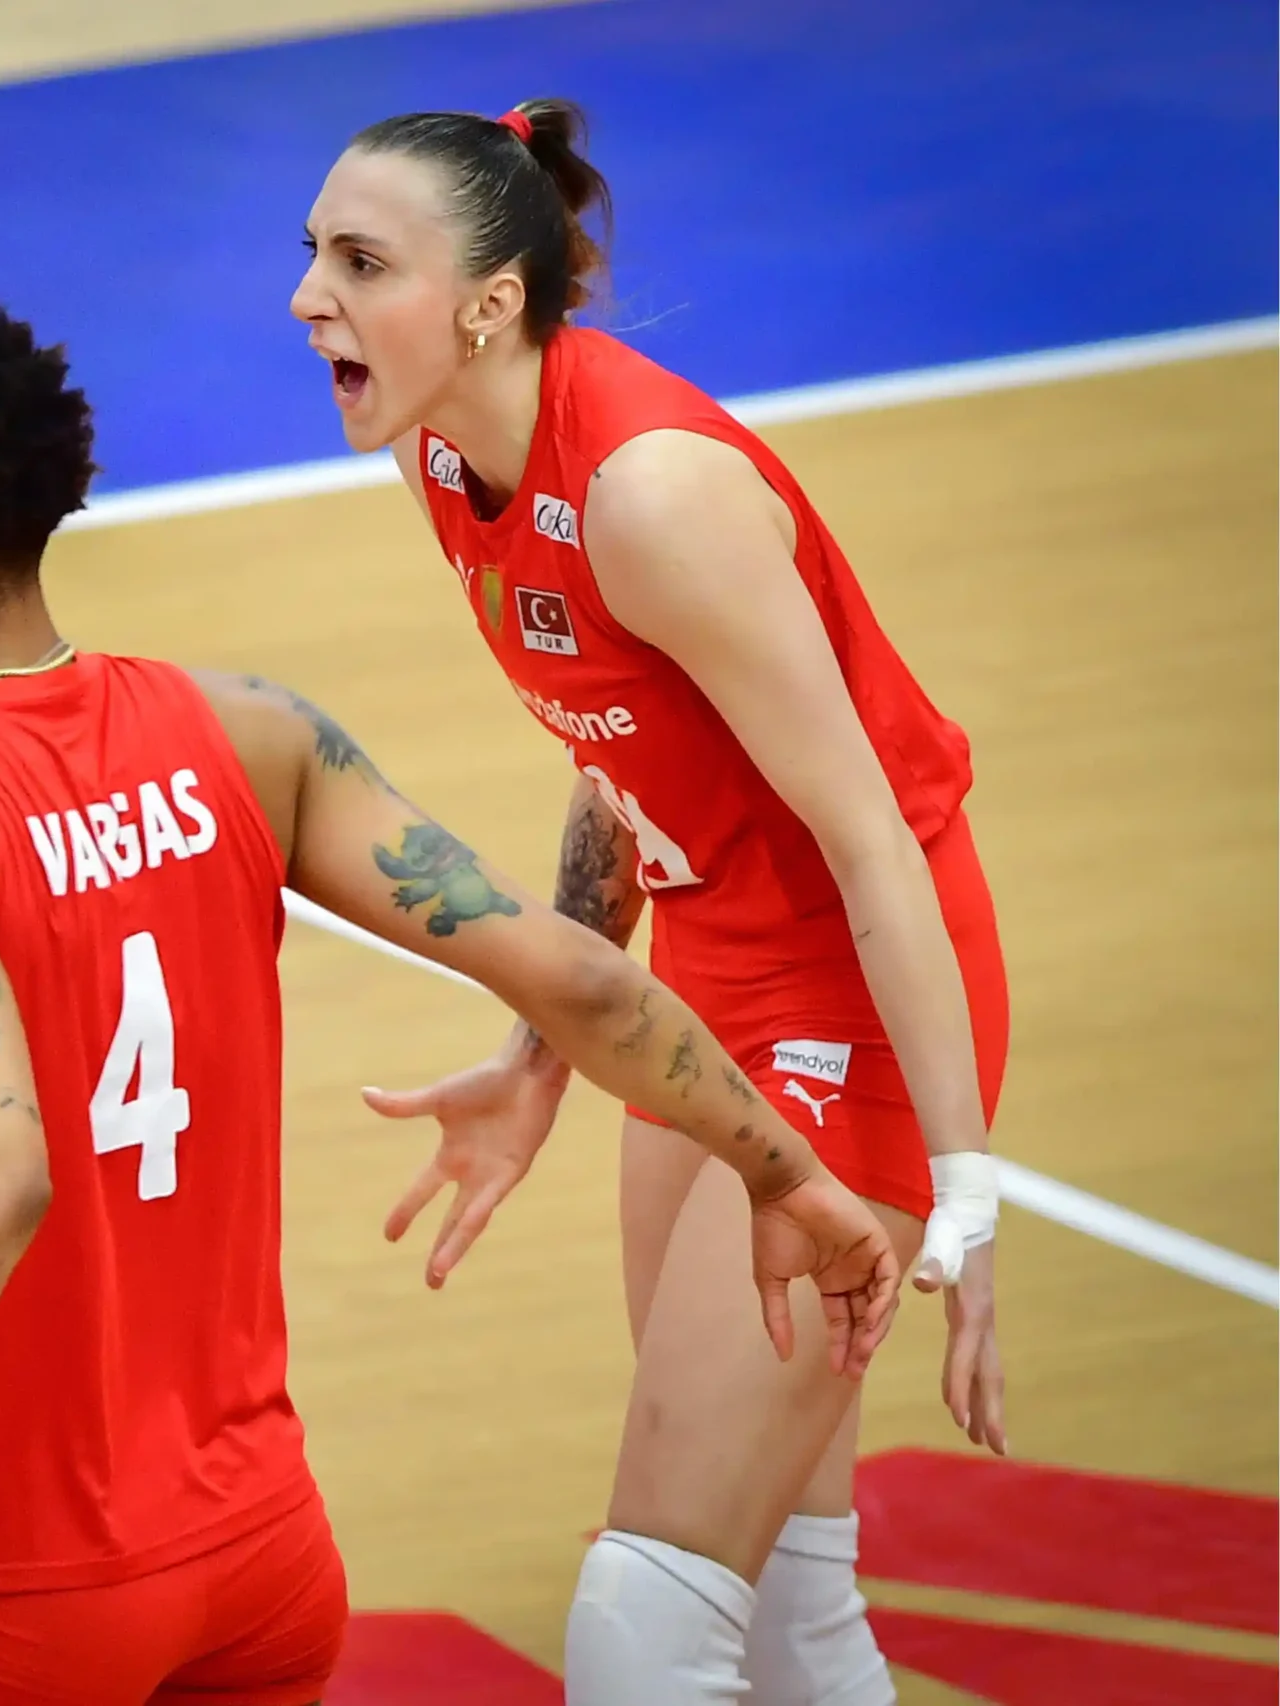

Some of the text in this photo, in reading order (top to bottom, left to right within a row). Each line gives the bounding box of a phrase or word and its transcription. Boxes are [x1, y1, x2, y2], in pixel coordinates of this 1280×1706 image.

[535, 634, 564, 650] TUR
[25, 768, 218, 896] VARGAS
[89, 930, 191, 1201] 4
